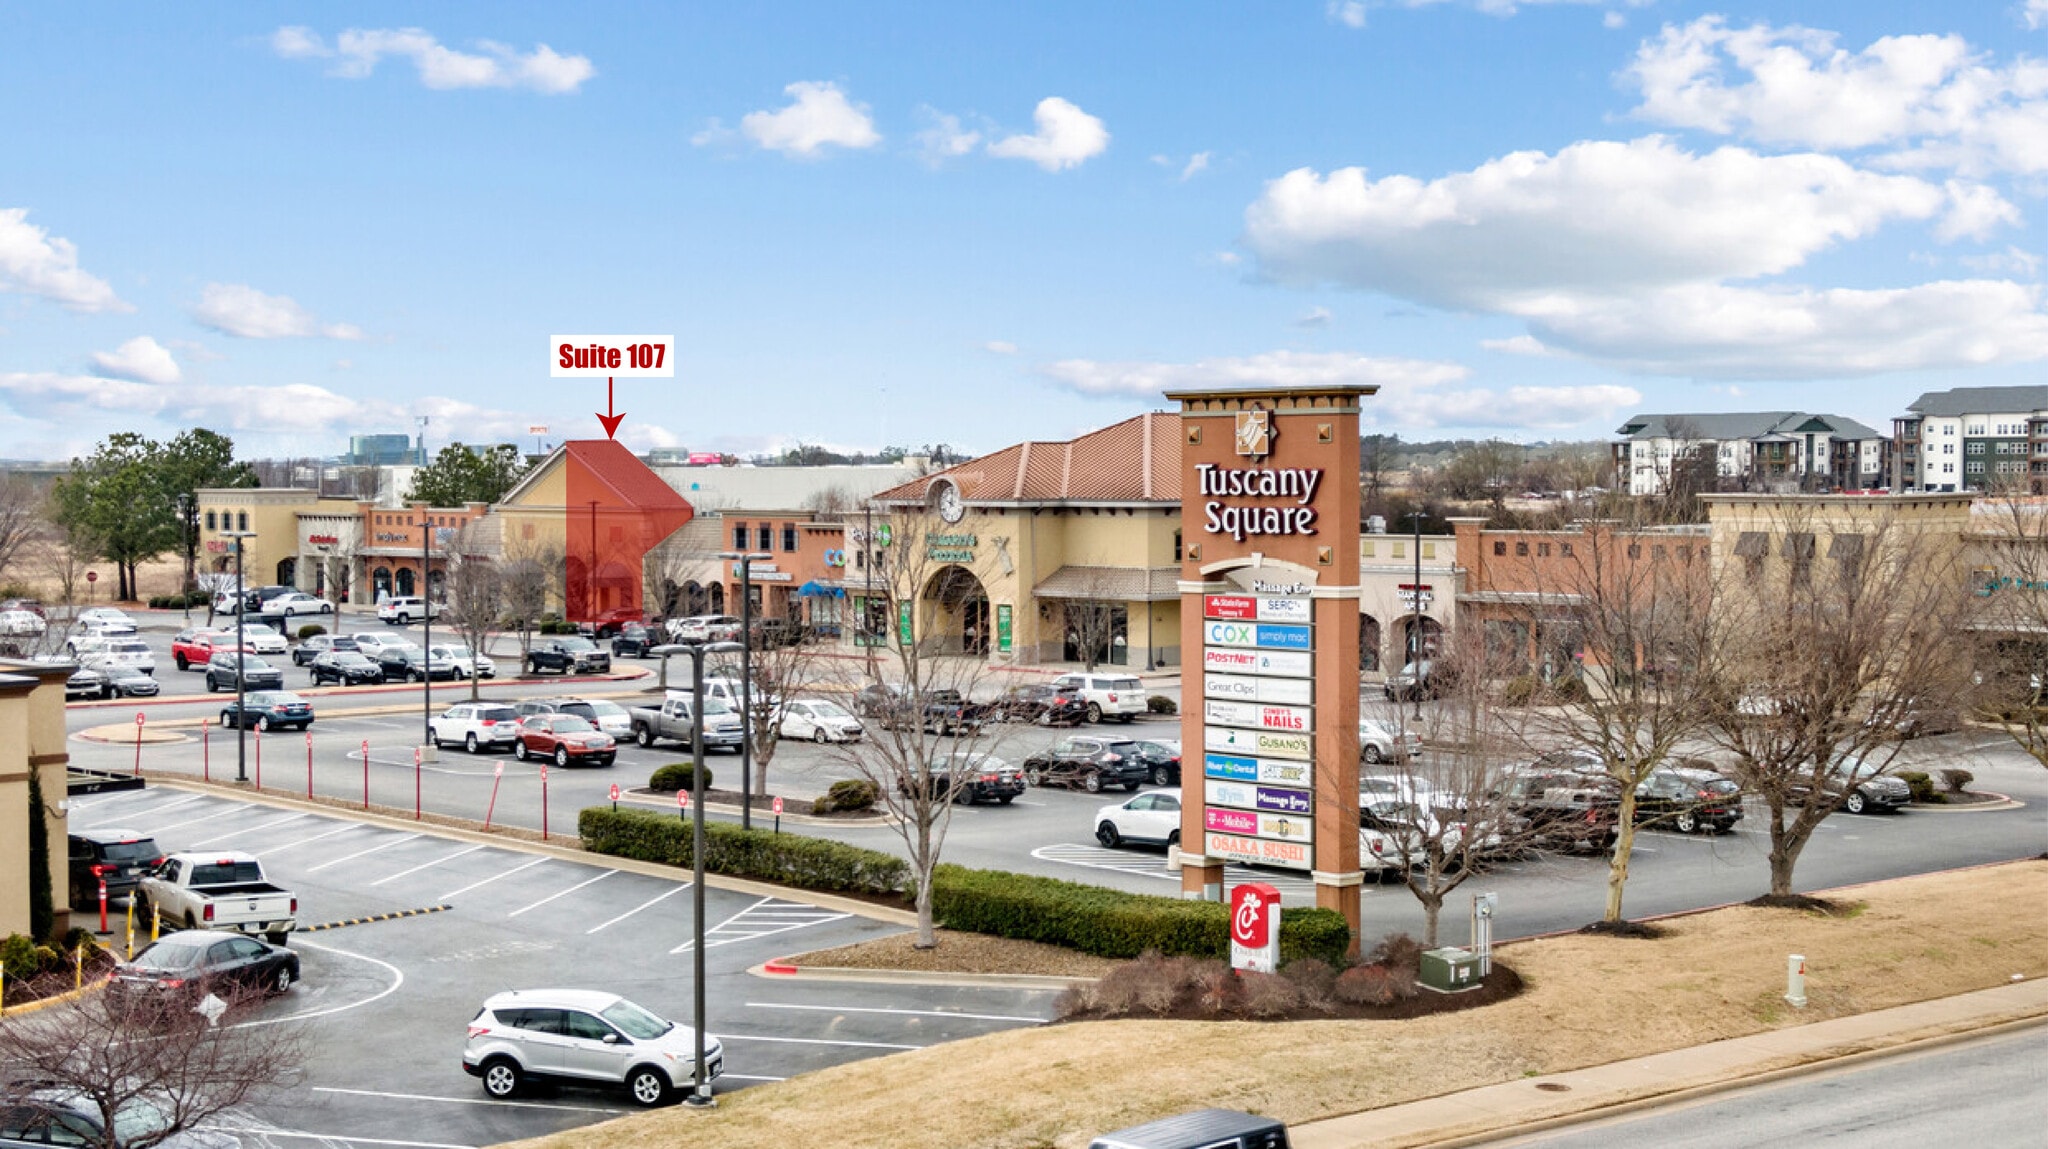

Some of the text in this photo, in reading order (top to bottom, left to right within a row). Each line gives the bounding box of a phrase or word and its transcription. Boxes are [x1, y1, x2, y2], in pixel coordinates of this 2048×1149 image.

[1194, 463, 1321, 505] Tuscany
[1203, 500, 1317, 542] Square
[1211, 624, 1250, 643] COX
[1259, 630, 1307, 643] simply mac
[1208, 681, 1232, 693] Great
[1233, 682, 1255, 695] Clips
[1263, 707, 1292, 716] CINDY'S
[1263, 714, 1303, 729] NAILS
[1211, 835, 1304, 861] OSAKA SUSHI
